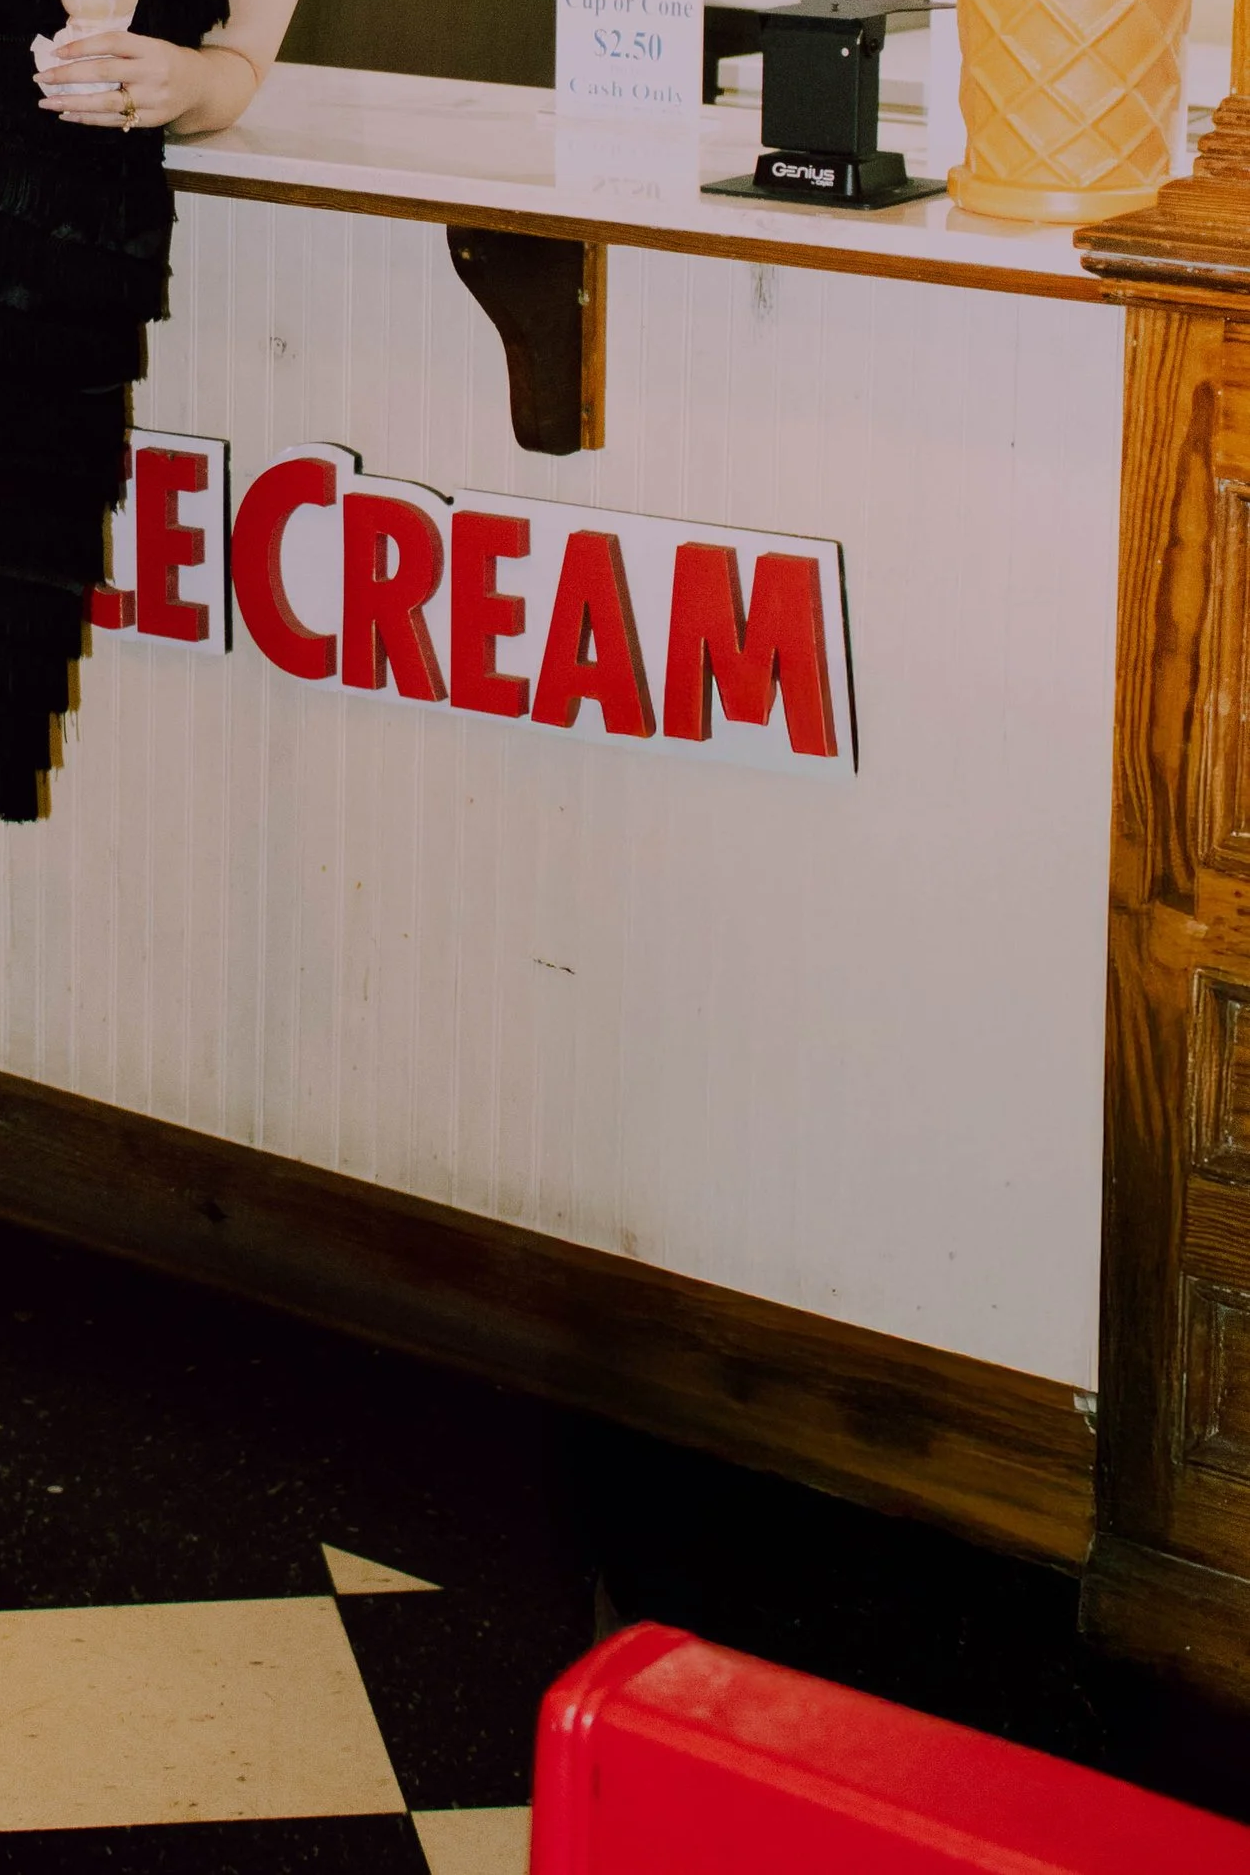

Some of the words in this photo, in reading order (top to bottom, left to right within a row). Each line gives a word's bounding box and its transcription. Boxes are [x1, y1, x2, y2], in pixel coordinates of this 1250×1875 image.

[594, 28, 663, 62] $2.50
[569, 77, 623, 98] Cash
[632, 83, 683, 107] Only
[772, 162, 835, 182] Genius
[231, 457, 839, 759] CREAM
